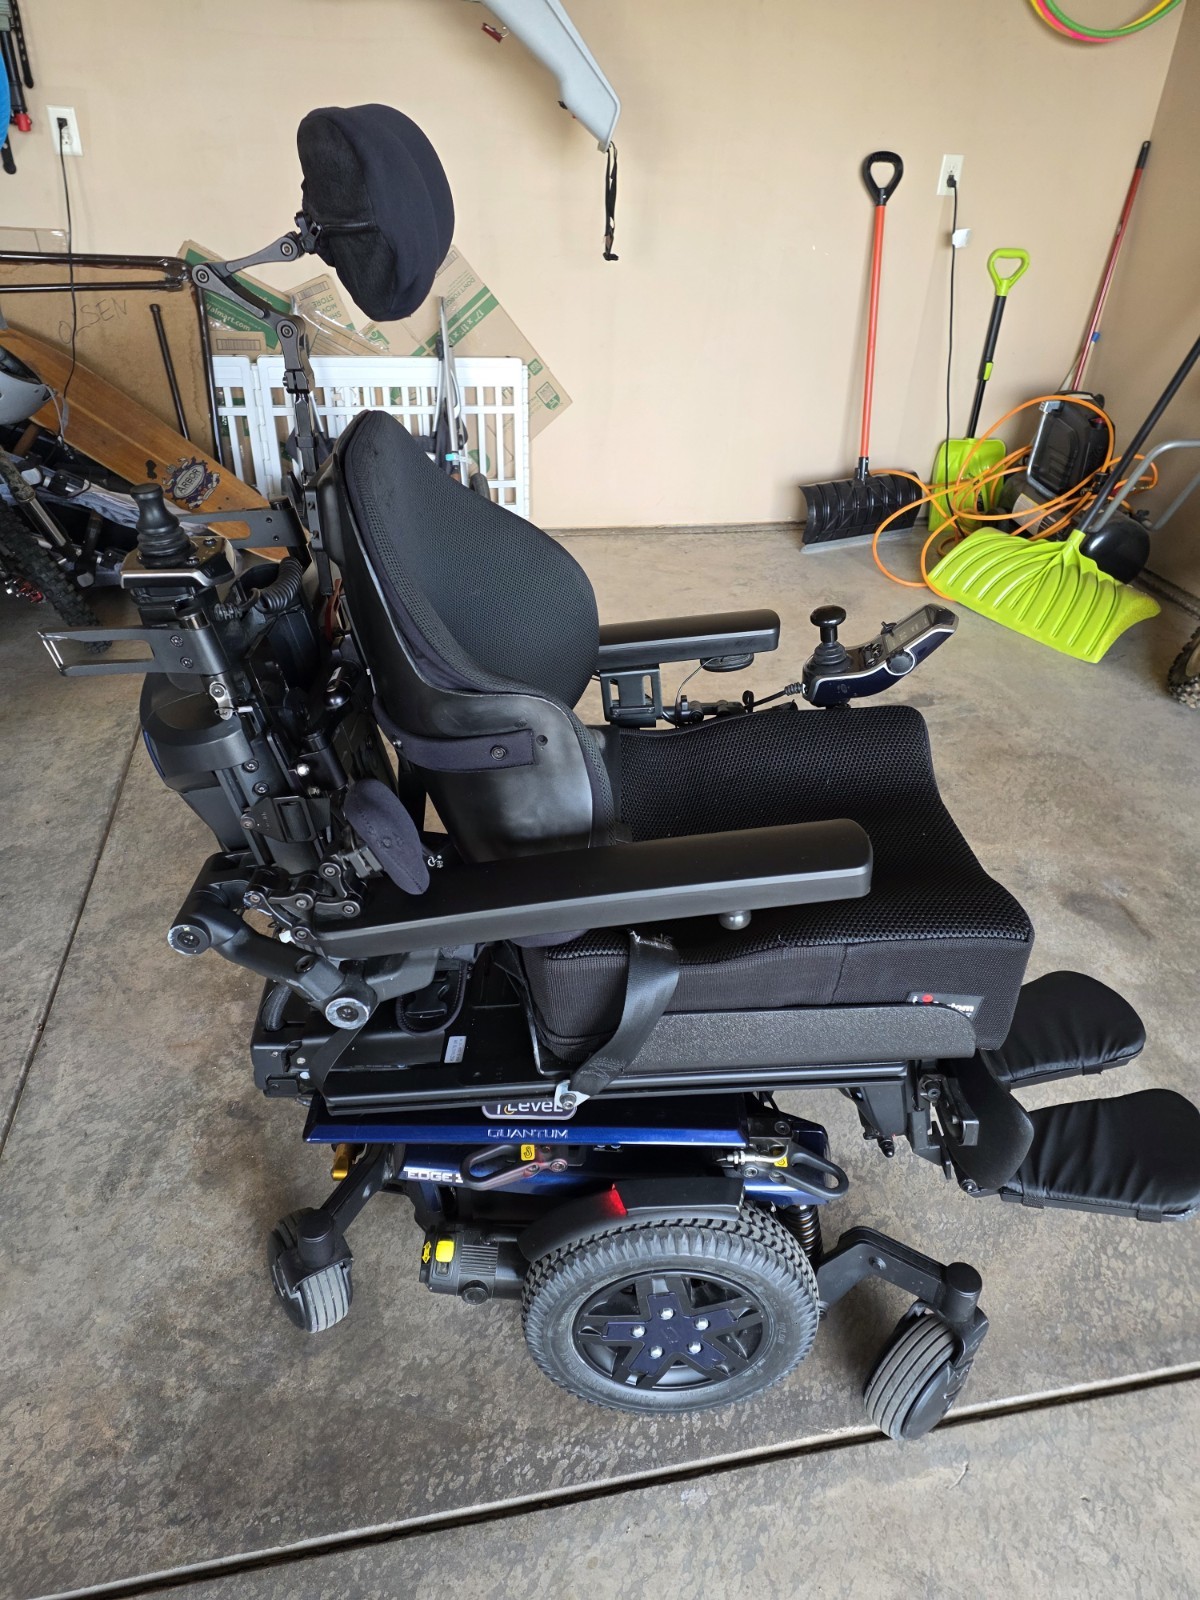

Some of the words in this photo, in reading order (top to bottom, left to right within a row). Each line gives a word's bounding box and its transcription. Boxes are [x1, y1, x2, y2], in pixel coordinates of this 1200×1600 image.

[311, 294, 334, 308] STORE
[177, 468, 201, 494] ARBOR
[487, 1128, 569, 1139] QUANTUM
[407, 1170, 453, 1183] EDGE
